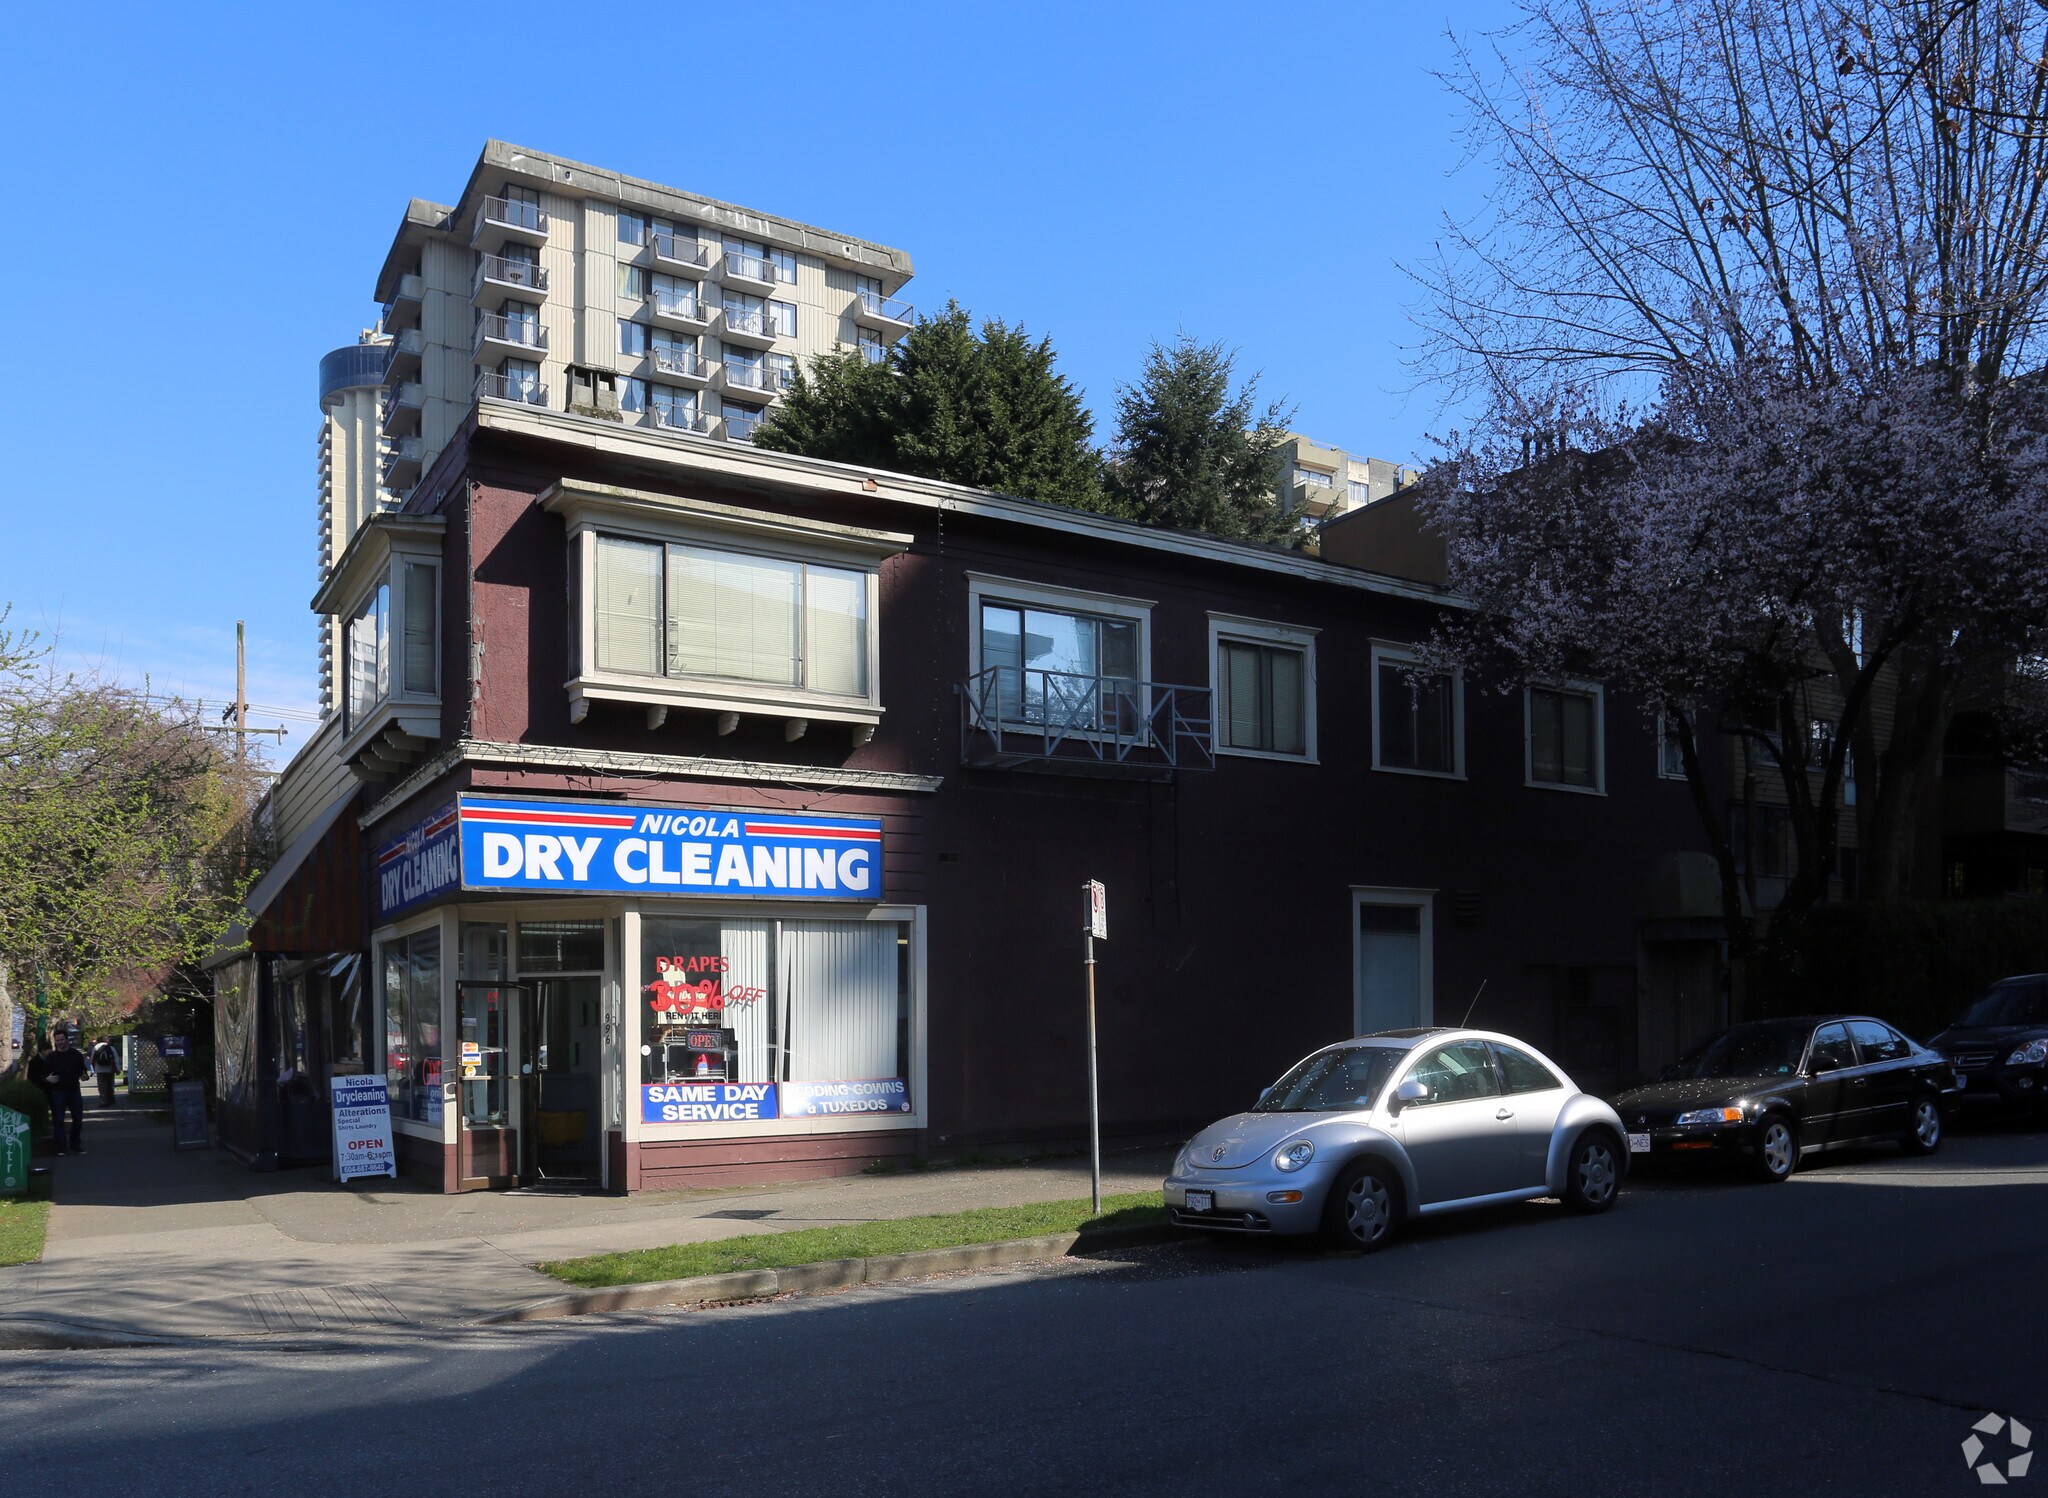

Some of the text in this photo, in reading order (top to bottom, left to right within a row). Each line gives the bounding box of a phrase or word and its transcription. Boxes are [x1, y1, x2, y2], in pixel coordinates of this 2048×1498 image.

[640, 814, 739, 838] NICOLA
[483, 832, 869, 891] DRY CLEANING
[382, 834, 457, 911] DRY CLEANING
[656, 956, 729, 973] DRAPES
[649, 980, 766, 1014] 30% OFF
[690, 1034, 720, 1048] OPEN
[346, 1077, 374, 1087] Nicola
[787, 1082, 905, 1097] EDDING GOWNS
[336, 1089, 386, 1105] Drycleaning
[648, 1085, 770, 1103] SAME DAY
[339, 1107, 387, 1117] Alterations
[662, 1103, 759, 1121] SERVICE
[807, 1098, 888, 1114] & TUXEDOS
[338, 1117, 361, 1125] Special
[348, 1139, 383, 1151] OPEN
